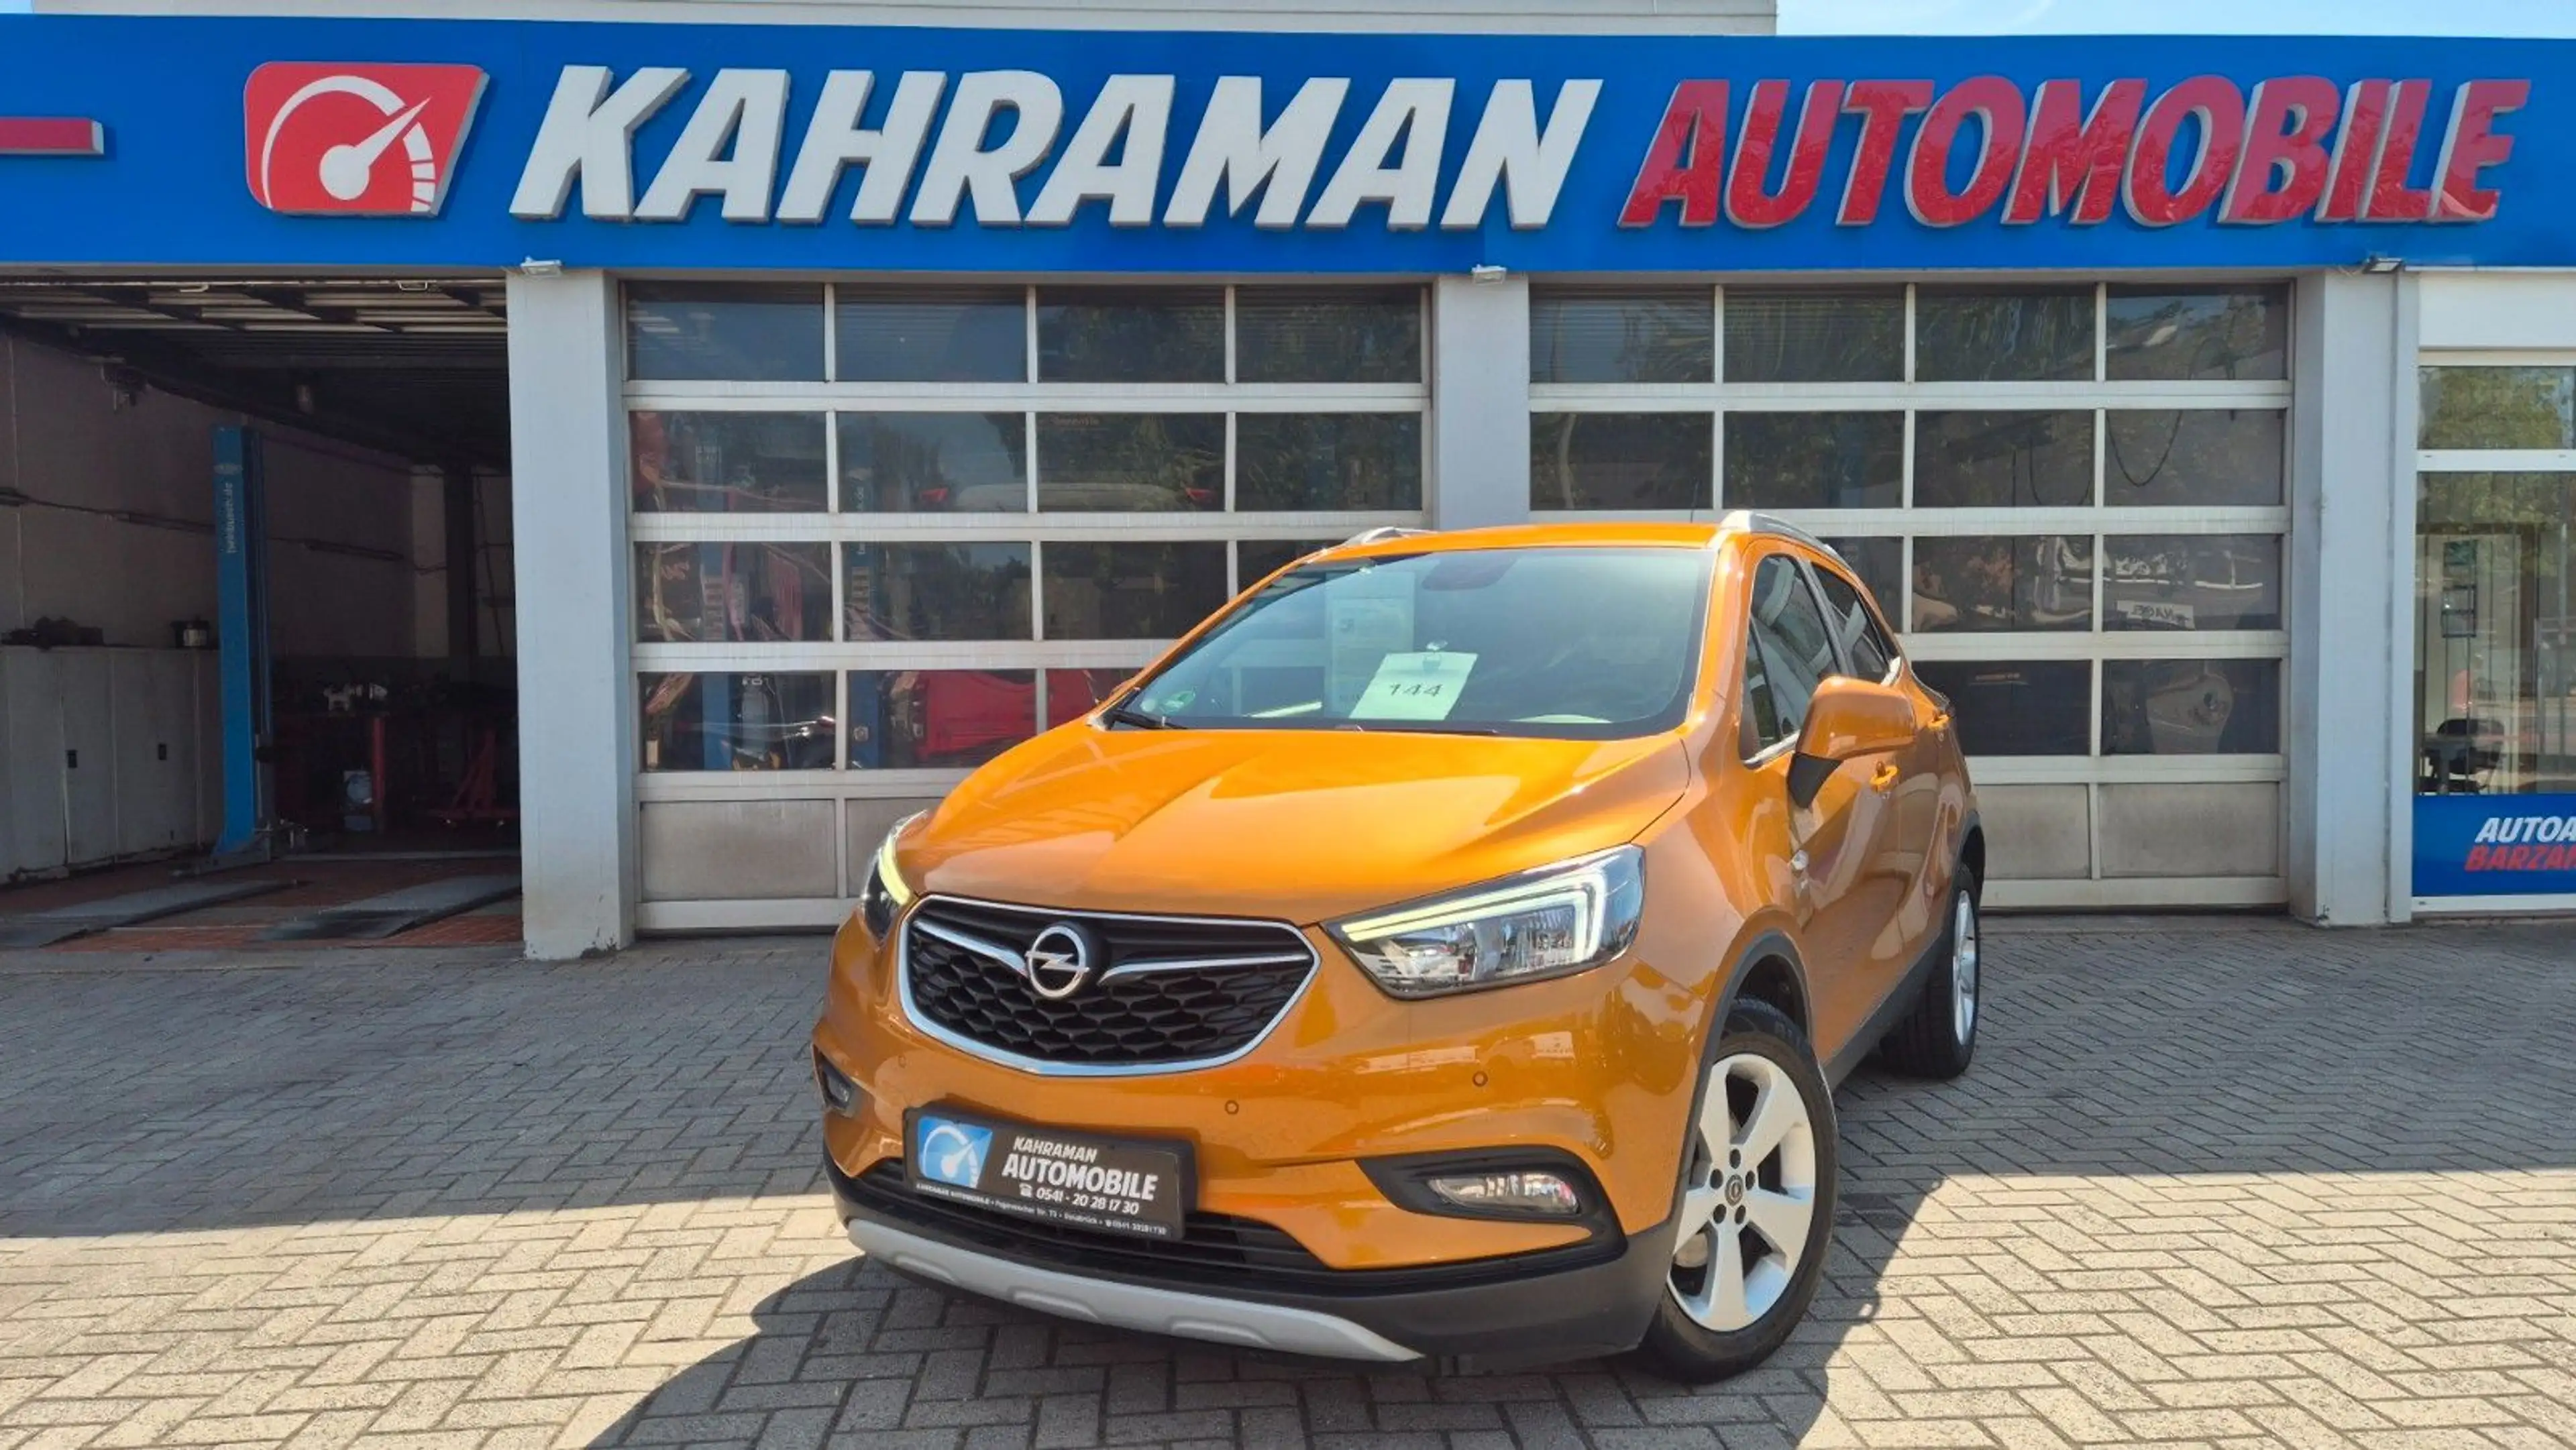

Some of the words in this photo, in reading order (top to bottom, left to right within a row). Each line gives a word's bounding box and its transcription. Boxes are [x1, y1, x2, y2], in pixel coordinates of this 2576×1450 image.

[508, 65, 1603, 229] KAHRAMAN
[1617, 75, 2532, 229] AUTOMOBILE
[1389, 683, 1443, 697] 144
[1013, 1136, 1097, 1164] KAHRAMAN
[1002, 1153, 1159, 1201] AUTOMOBILE
[1036, 1187, 1064, 1203] 0541
[1072, 1193, 1089, 1207] 20
[1089, 1196, 1106, 1210] 28
[1109, 1198, 1121, 1212] 17
[1122, 1201, 1139, 1215] 30
